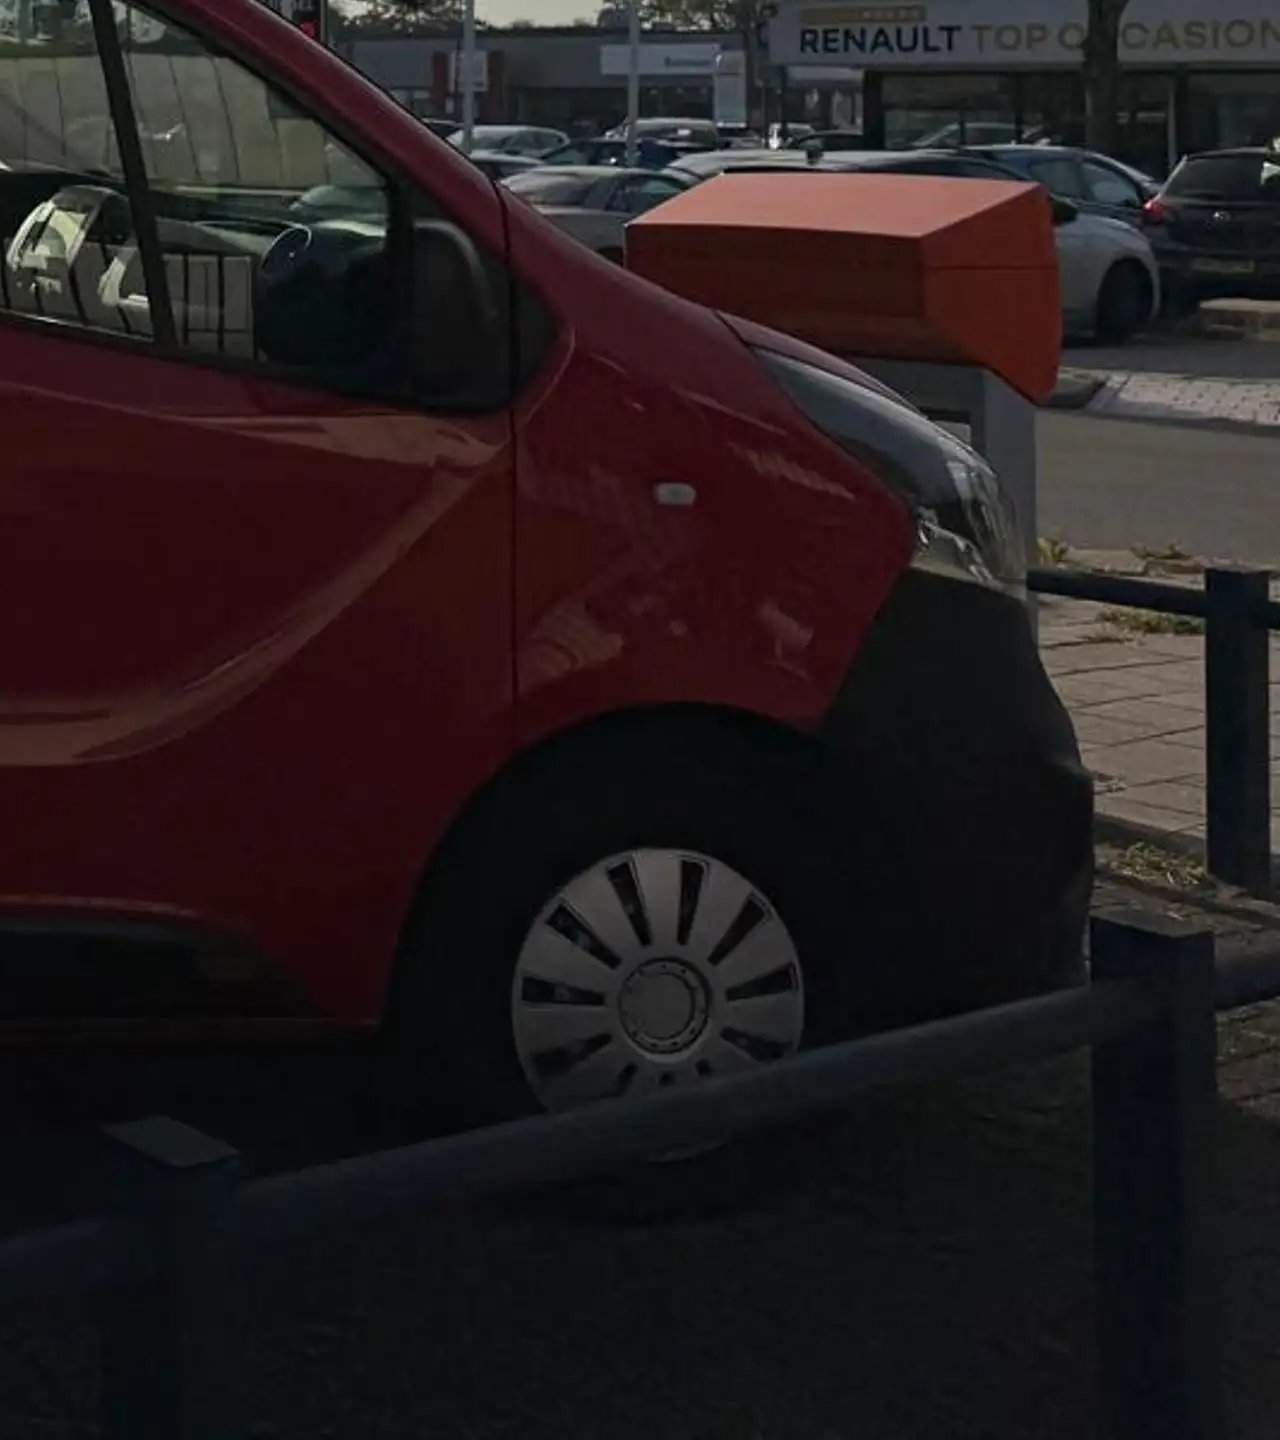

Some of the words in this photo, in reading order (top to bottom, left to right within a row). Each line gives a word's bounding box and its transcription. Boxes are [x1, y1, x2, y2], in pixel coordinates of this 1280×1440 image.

[800, 25, 962, 54] RENAULT
[970, 24, 1048, 53] TOP
[1057, 18, 1280, 51] OCASION
